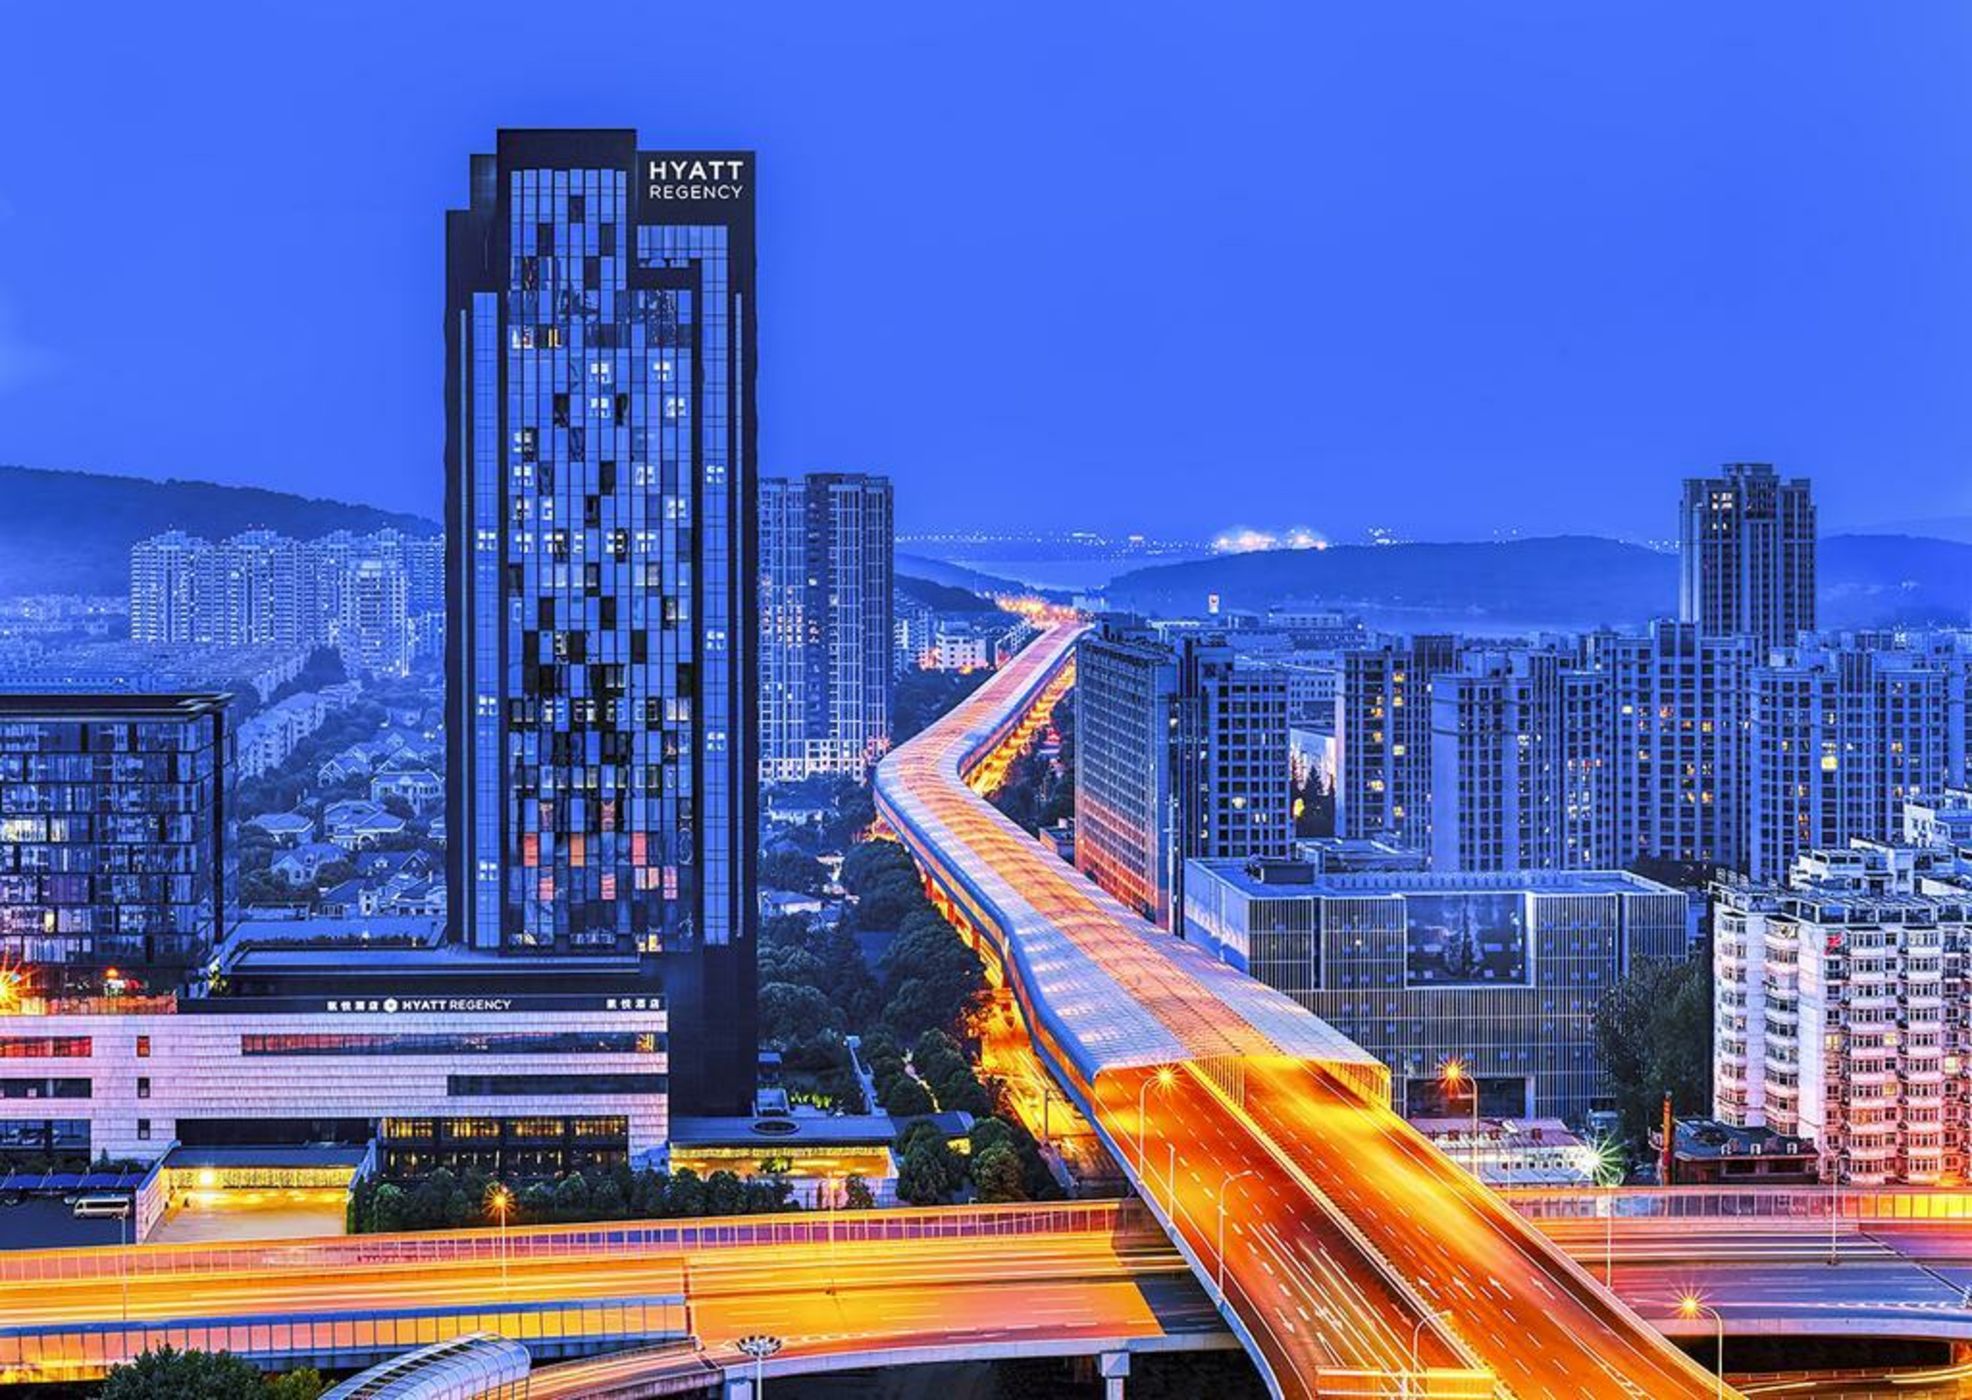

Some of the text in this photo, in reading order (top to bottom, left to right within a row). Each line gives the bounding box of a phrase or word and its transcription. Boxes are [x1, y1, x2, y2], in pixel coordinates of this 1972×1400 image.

[649, 160, 744, 181] HYATT
[649, 184, 743, 200] REGENCY
[402, 999, 511, 1011] HYATT REGENCY
